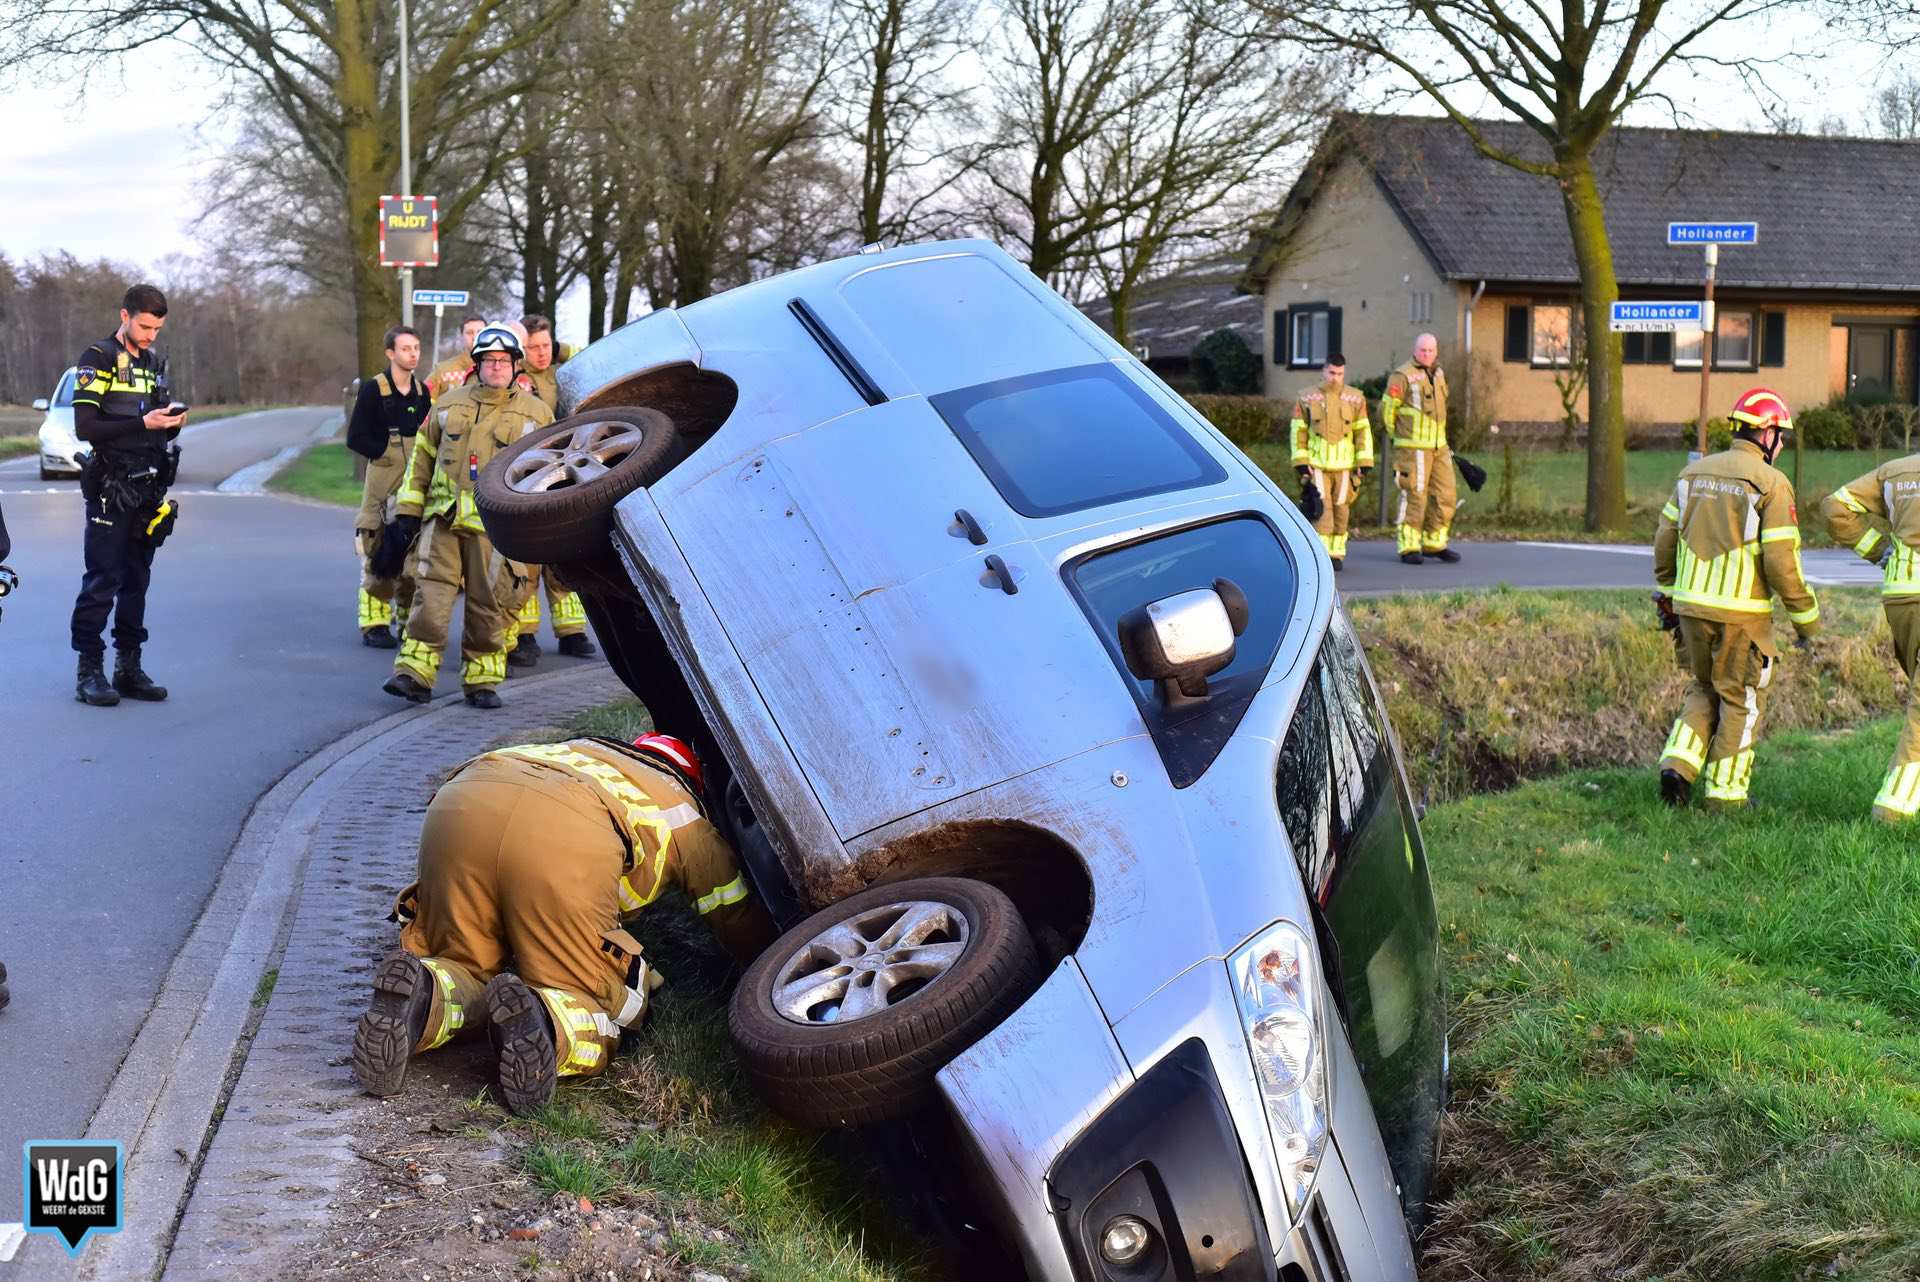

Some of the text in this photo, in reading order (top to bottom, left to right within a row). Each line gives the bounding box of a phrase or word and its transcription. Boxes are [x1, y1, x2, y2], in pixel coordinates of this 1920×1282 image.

[402, 202, 413, 214] U
[389, 216, 428, 228] RIJDT
[1678, 228, 1747, 240] Hollander
[1621, 306, 1692, 318] Hollander
[1692, 480, 1744, 496] RANDWEE
[1896, 480, 1920, 491] BRA
